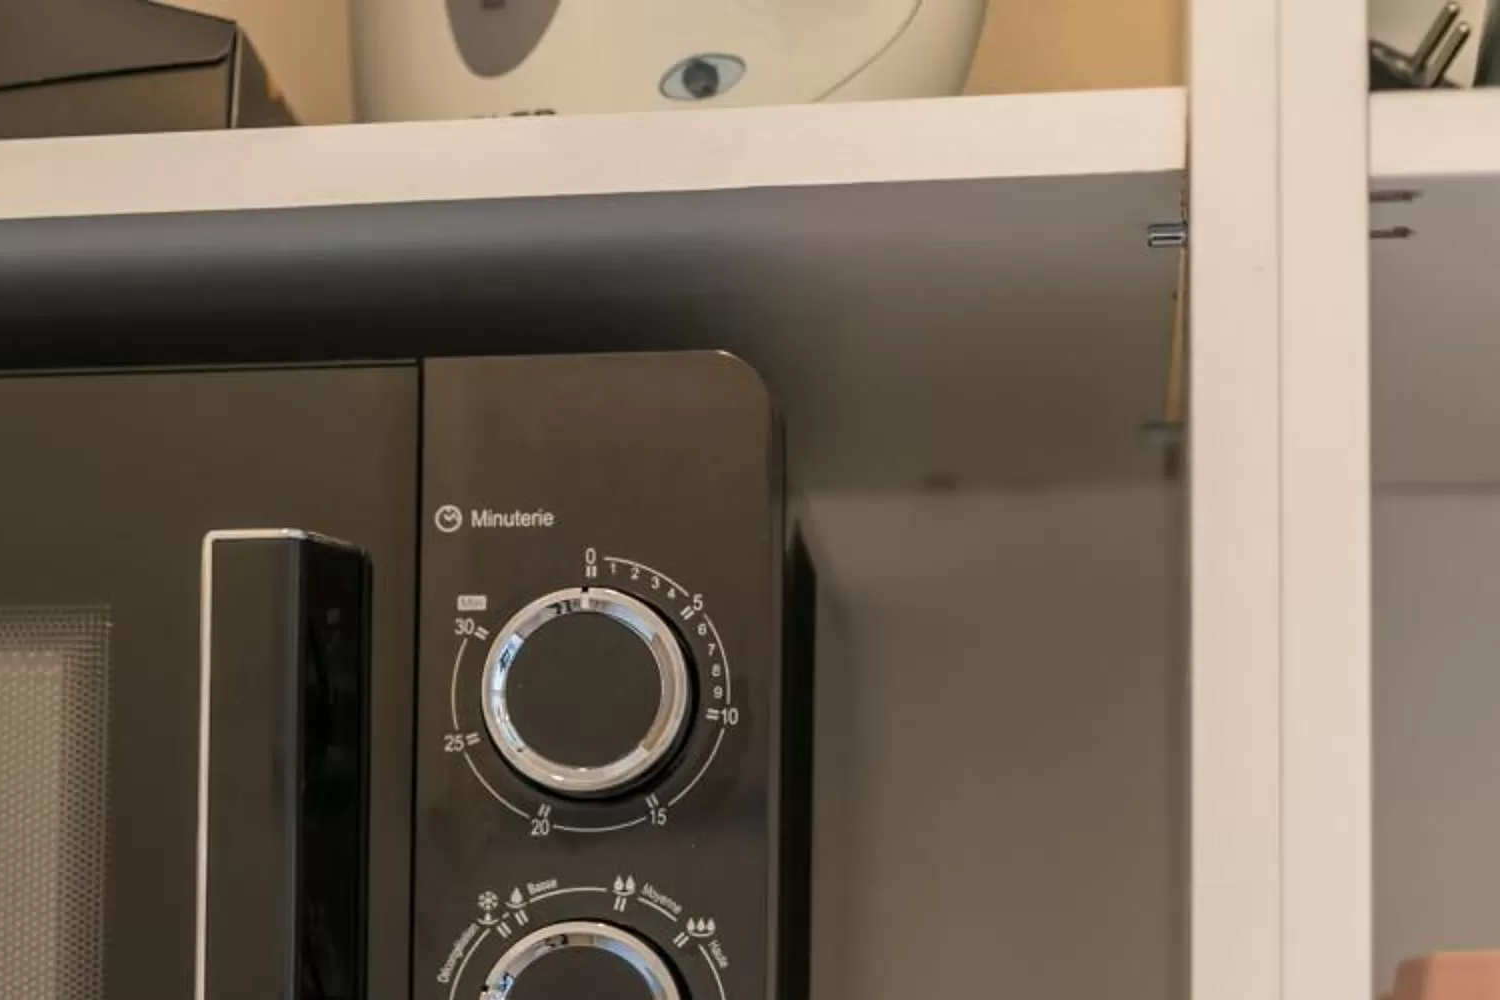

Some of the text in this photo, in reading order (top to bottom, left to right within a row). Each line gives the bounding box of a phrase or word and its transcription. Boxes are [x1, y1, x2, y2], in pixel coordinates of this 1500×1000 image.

[470, 508, 555, 528] Minuterie
[585, 547, 597, 565] 0
[611, 562, 617, 574] 1
[631, 567, 640, 580] 2
[651, 576, 660, 590] 3
[667, 588, 676, 600] 4
[693, 593, 703, 611] 5
[454, 617, 475, 636] 30
[697, 623, 707, 636] 6
[707, 643, 716, 657] 7
[711, 663, 721, 677] 8
[721, 707, 739, 725] 10
[444, 733, 465, 752] 25
[650, 808, 668, 826] 15
[530, 818, 550, 837] 20
